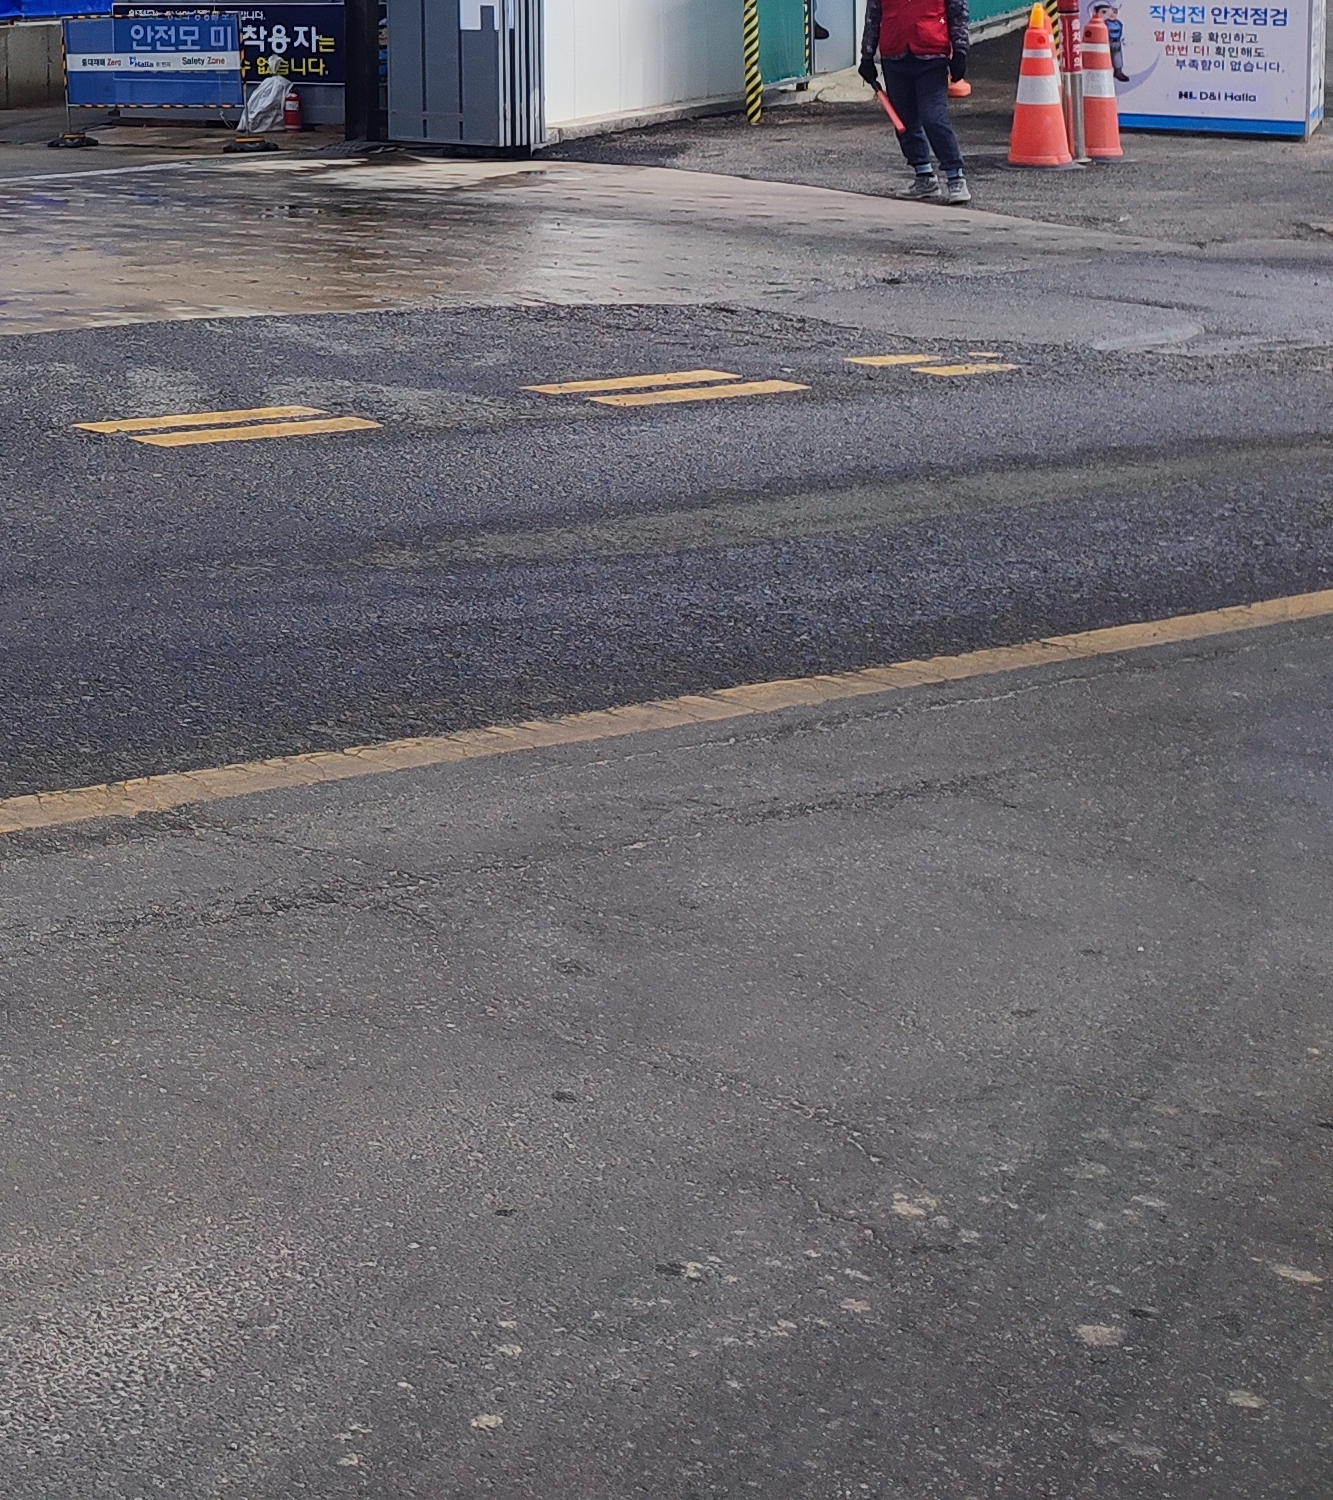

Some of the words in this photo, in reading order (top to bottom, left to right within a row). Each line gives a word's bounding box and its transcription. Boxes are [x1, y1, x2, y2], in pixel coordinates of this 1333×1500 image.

[1149, 4, 1206, 24] 작업전
[1210, 6, 1288, 27] 안전점검
[130, 24, 201, 51] 안전모
[210, 26, 232, 51] 미
[243, 24, 335, 54] 착용자는
[1153, 30, 1165, 42] 열
[1191, 31, 1203, 43] 을
[1207, 31, 1258, 44] 확인하고
[1165, 44, 1188, 57] 한번
[1193, 45, 1210, 57] 더!
[1214, 46, 1265, 58] 확인해도
[107, 58, 122, 66] Zero
[181, 56, 205, 67] Safety
[206, 56, 226, 66] Zone
[1175, 58, 1225, 71] 부족함이
[1230, 60, 1285, 73] 없습니다.
[1199, 91, 1221, 101] D&I
[1224, 92, 1257, 102] Halla
